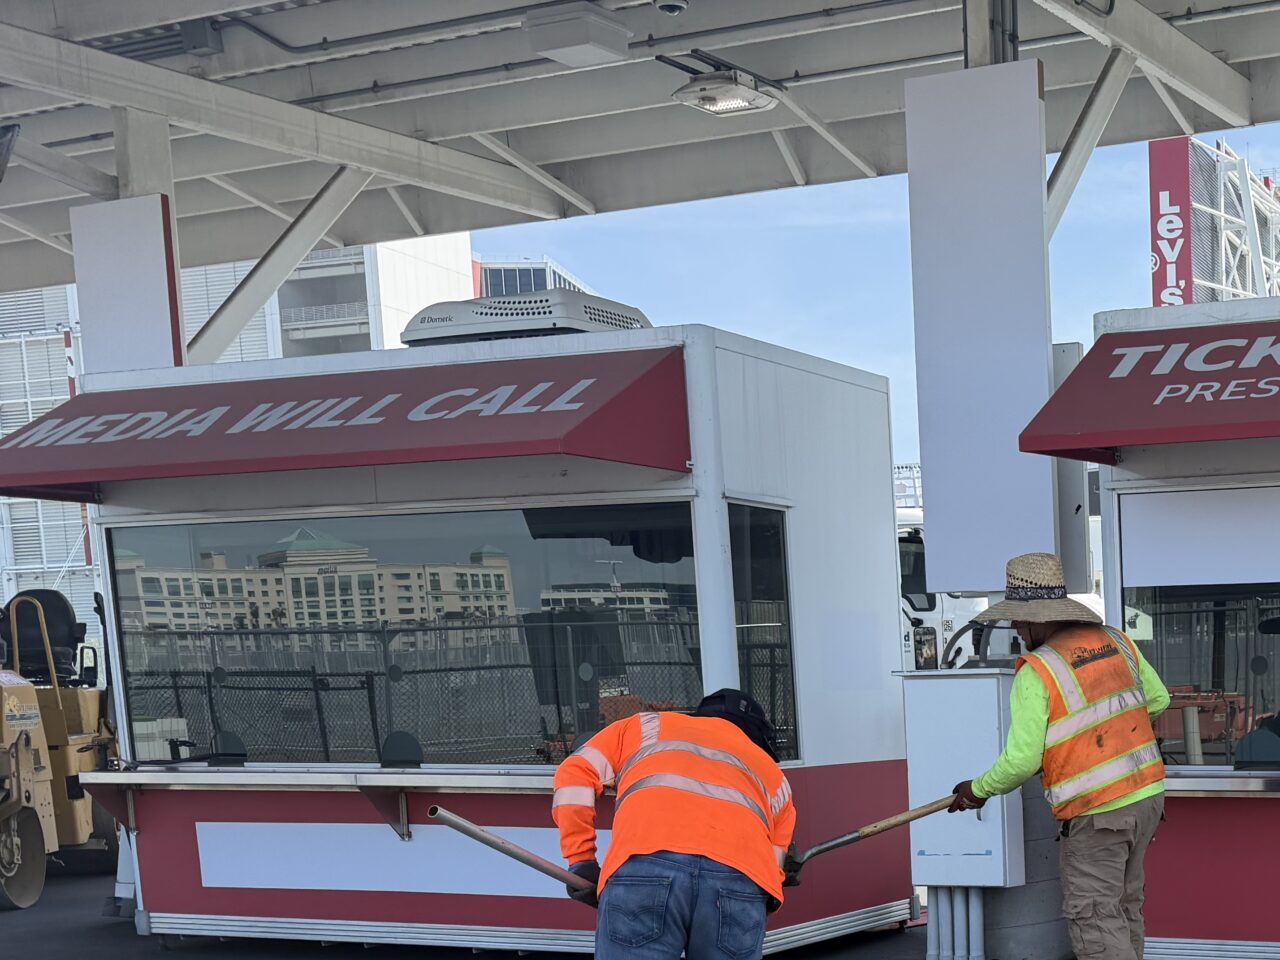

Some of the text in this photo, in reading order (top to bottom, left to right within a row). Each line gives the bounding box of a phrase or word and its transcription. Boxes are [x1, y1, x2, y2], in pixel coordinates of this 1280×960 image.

[1157, 190, 1185, 306] Levi's
[426, 315, 454, 323] Dometic
[0, 378, 597, 449] MEDIA WILL CALL
